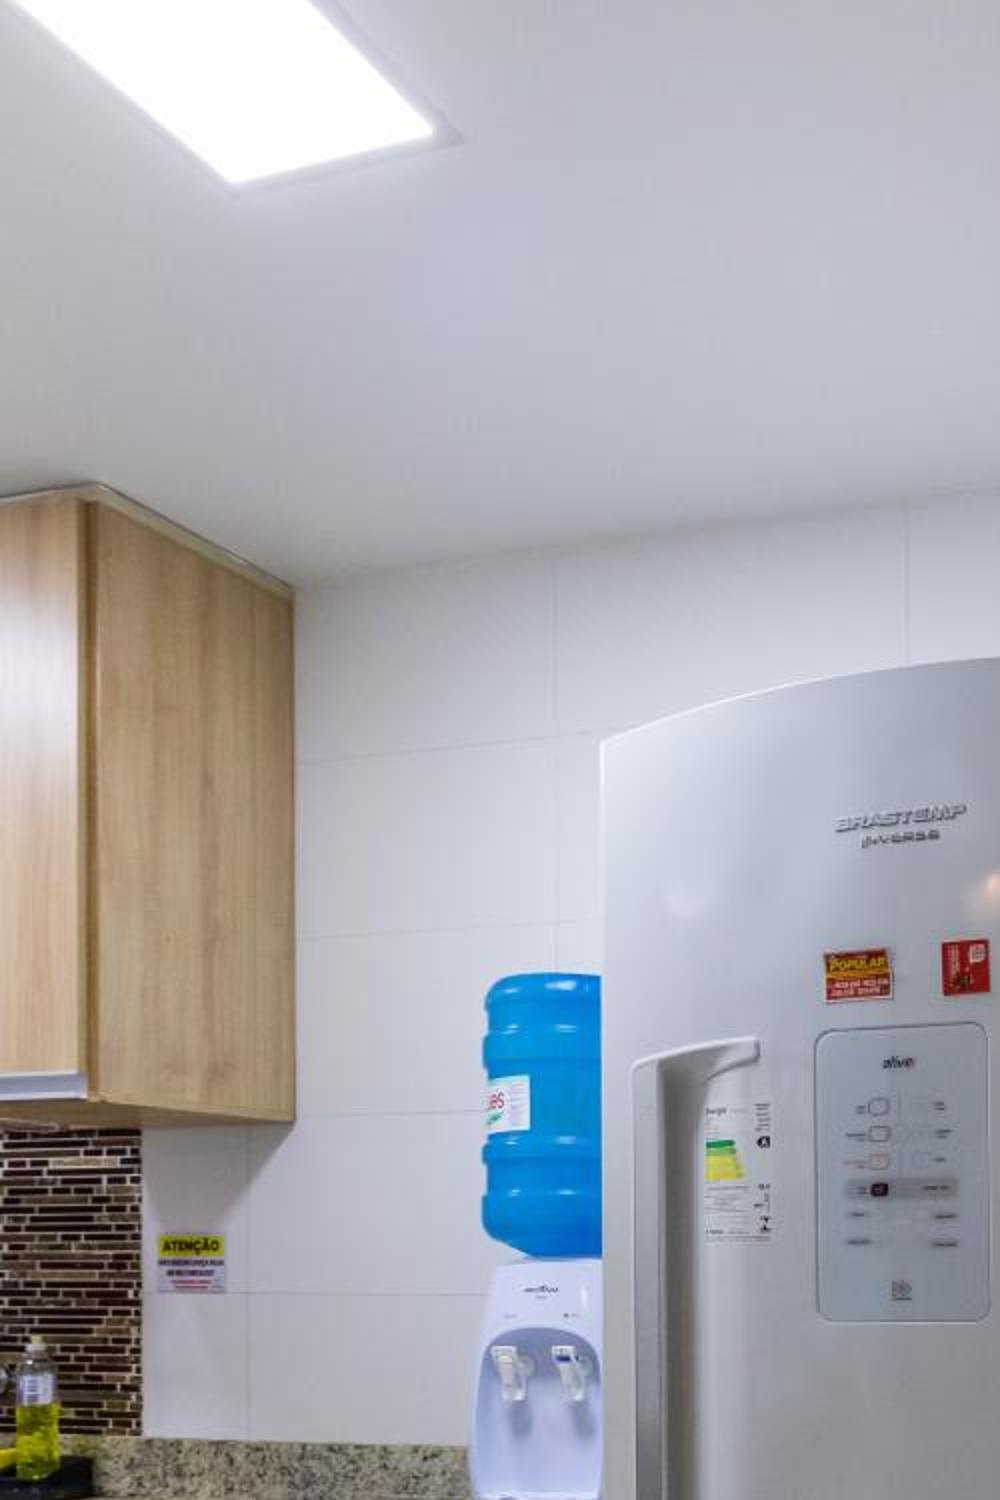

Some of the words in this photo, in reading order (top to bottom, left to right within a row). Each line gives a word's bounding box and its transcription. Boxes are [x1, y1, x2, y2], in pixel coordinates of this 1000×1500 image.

[835, 803, 967, 833] BRASTEMP
[830, 956, 885, 972] POPULAR
[162, 1236, 220, 1256] ATENÇÃO
